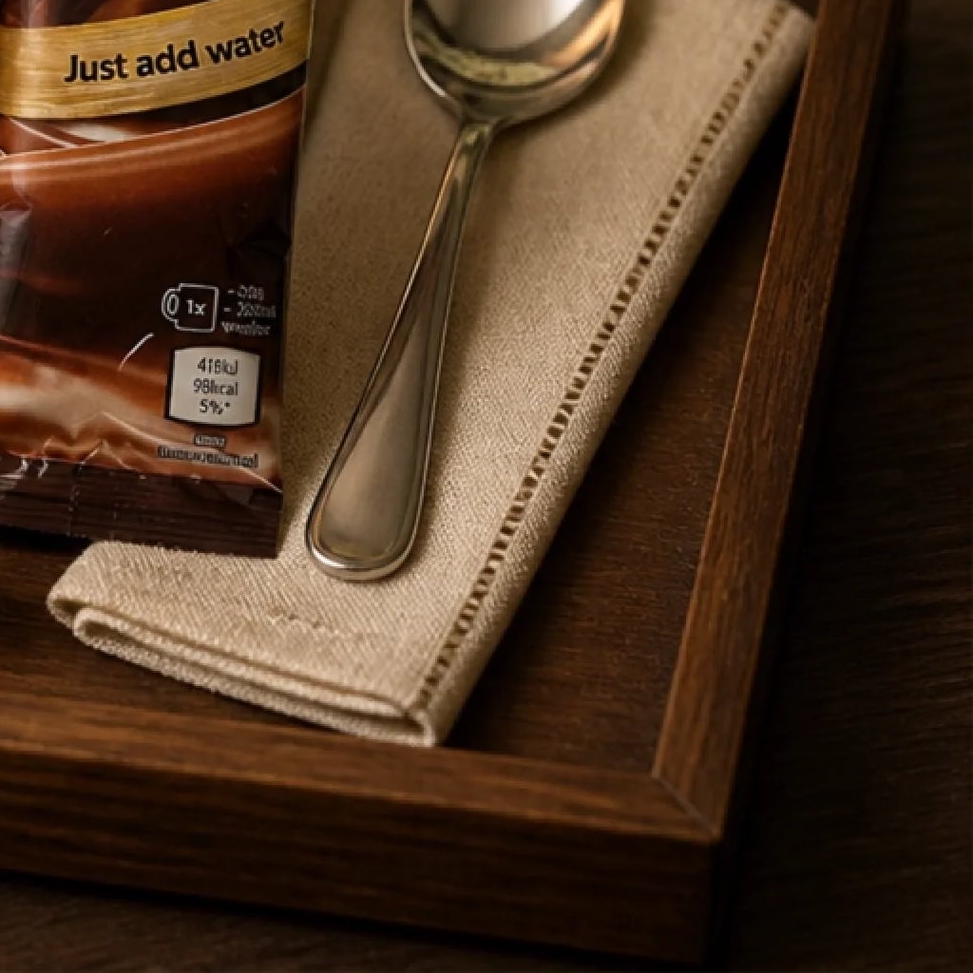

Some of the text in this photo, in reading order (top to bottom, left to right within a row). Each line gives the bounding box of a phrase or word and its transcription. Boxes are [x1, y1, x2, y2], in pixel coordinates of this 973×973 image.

[63, 20, 285, 82] Just add water
